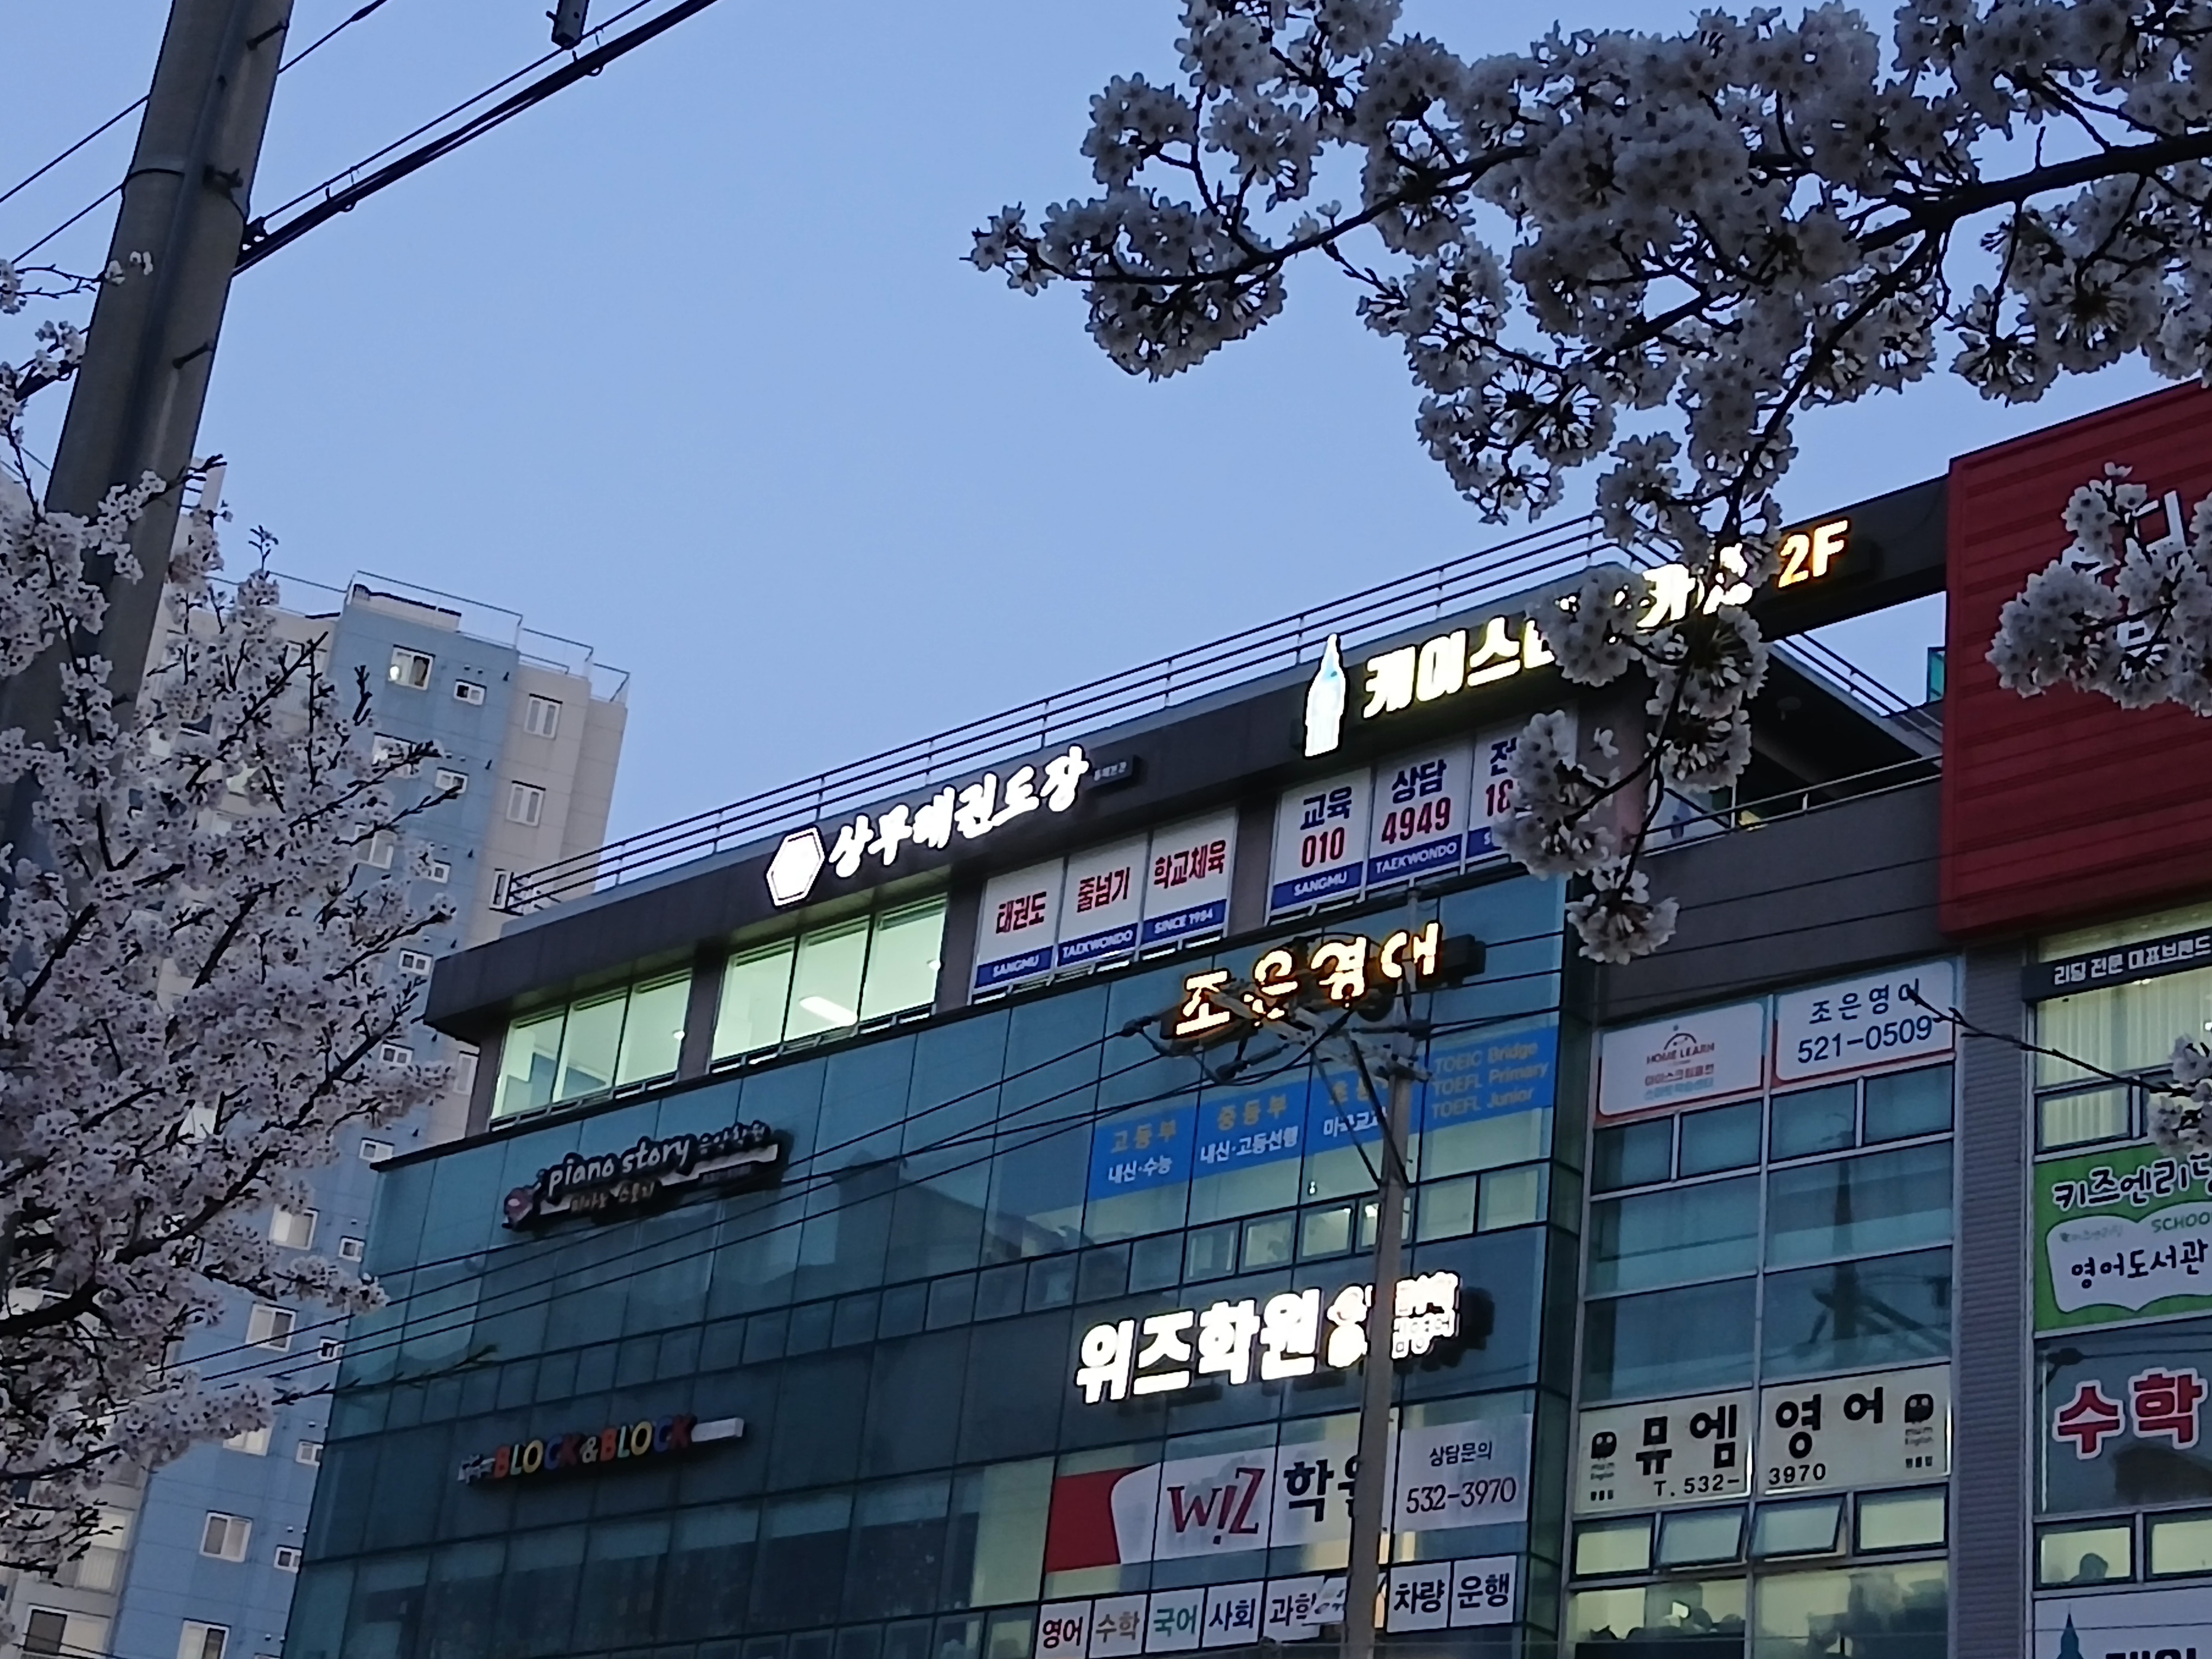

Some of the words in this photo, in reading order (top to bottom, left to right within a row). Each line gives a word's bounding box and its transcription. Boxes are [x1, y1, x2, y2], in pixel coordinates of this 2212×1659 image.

[1777, 519, 1849, 589] 2F
[1391, 759, 1446, 804] 상담
[1300, 786, 1352, 830] 교육
[1381, 796, 1451, 845] 4949
[1154, 840, 1226, 889] 학교체육
[1301, 827, 1345, 868] 010
[1375, 841, 1458, 874] TAEKWONDO
[1077, 867, 1130, 913] 줄넘기
[1294, 871, 1348, 896] SANGMU
[995, 891, 1047, 934] 태권도
[1154, 915, 1187, 934] SINCE
[1063, 929, 1134, 959] TAEKWONDO
[993, 955, 1040, 978] SANGMU
[2054, 962, 2086, 986] 리딩
[2091, 954, 2124, 978] 전문
[1797, 1014, 1933, 1064] 521-0509
[1433, 1050, 1483, 1074] TOEIC
[1487, 1042, 1538, 1064] Bridge
[1647, 1050, 1677, 1065] HOME
[1432, 1073, 1482, 1097] TOEFL
[1488, 1062, 1549, 1084] Primary
[1431, 1095, 1482, 1119] TOEFL
[1486, 1087, 1535, 1109] Junior
[548, 1158, 615, 1197] piano
[622, 1139, 690, 1174] story
[2151, 1211, 2212, 1233] SCHOO
[2071, 1238, 2209, 1289] 영어도서관
[1076, 1288, 1322, 1404] 위즈학원
[2055, 1372, 2204, 1455] 수학
[1429, 1441, 1493, 1467] 상담문의
[1406, 1476, 1516, 1515] 532-3970
[1394, 1578, 1445, 1616] 차량
[1456, 1573, 1511, 1609] 운행
[1094, 1610, 1141, 1643] 수학
[1153, 1603, 1197, 1637] 국어
[1208, 1598, 1256, 1630] 사회
[1041, 1616, 1084, 1649] 영어
